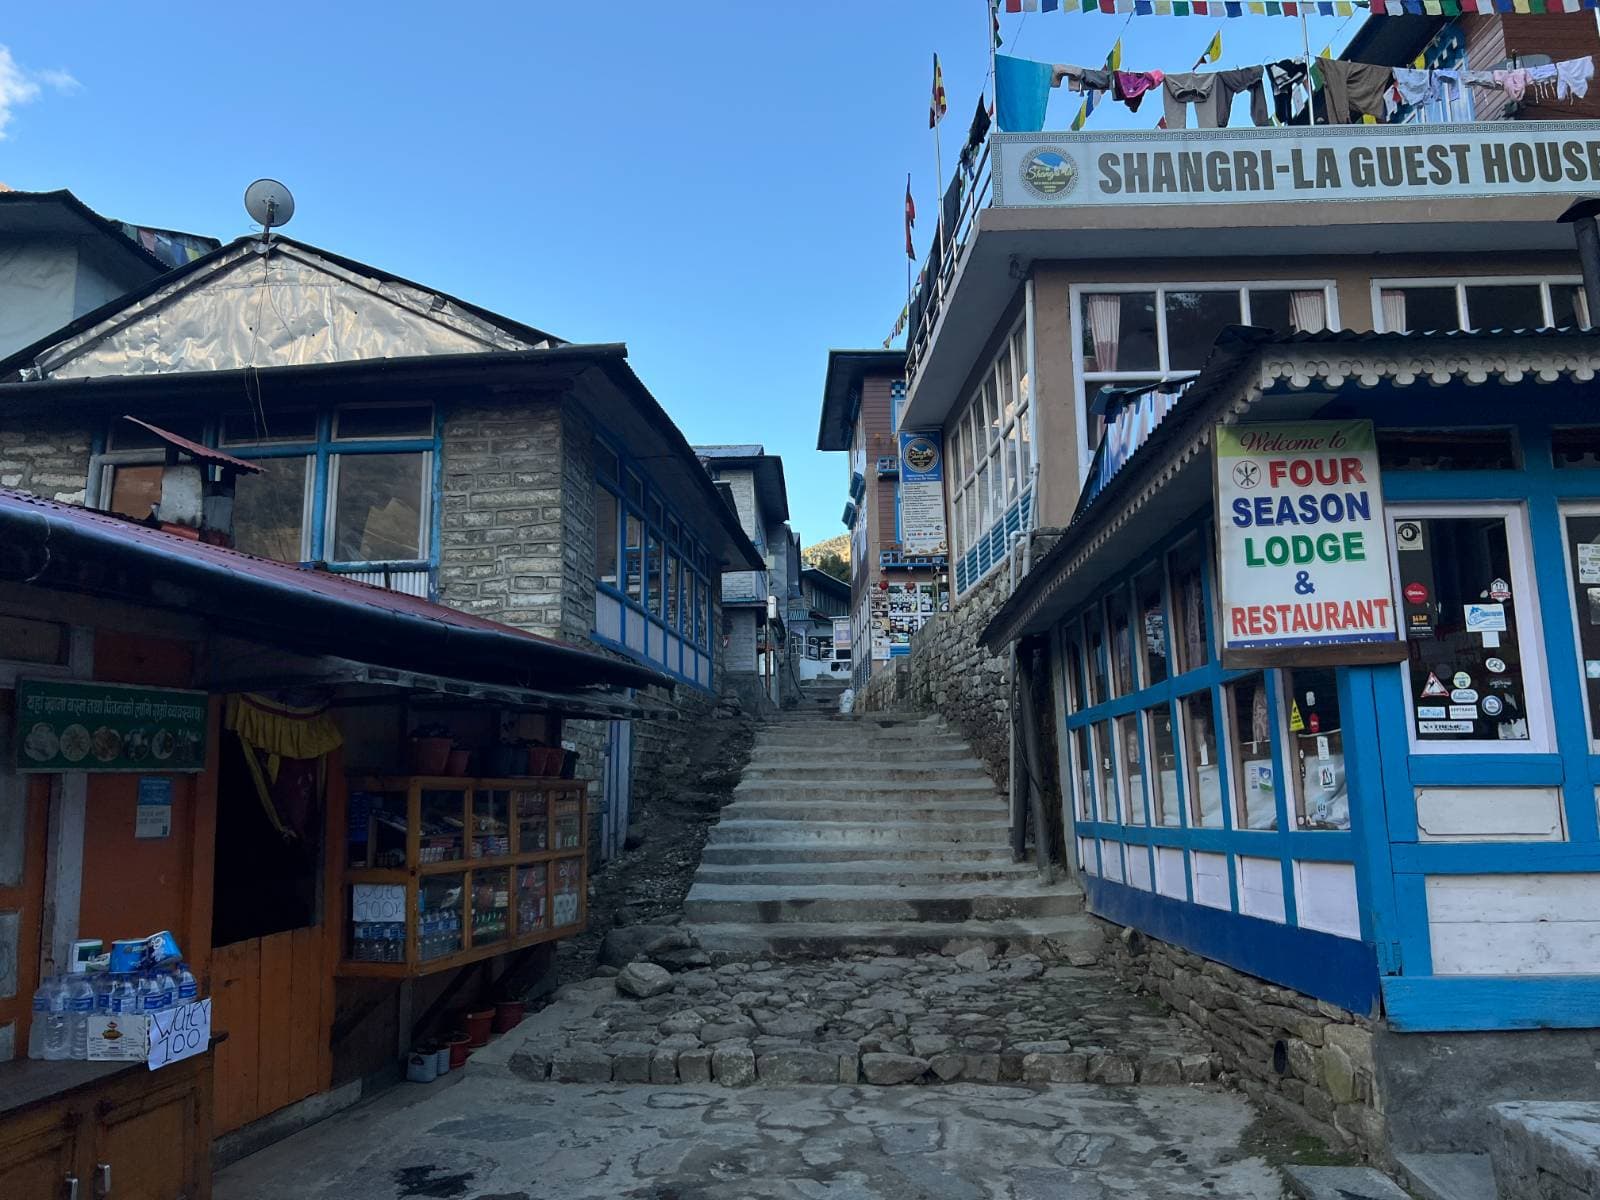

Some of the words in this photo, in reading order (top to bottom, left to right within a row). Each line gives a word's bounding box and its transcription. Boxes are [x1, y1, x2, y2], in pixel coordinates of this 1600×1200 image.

[1098, 149, 1341, 193] SHANGRI-LA
[1349, 144, 1470, 187] GUEST
[1240, 431, 1324, 452] Welcome
[1329, 430, 1346, 448] to
[1269, 457, 1367, 488] FOUR
[1232, 491, 1371, 528] SEASON
[1244, 531, 1366, 567] LODGE
[1294, 570, 1315, 595] &
[1231, 598, 1389, 636] RESTAURANT
[158, 1028, 201, 1064] 100
